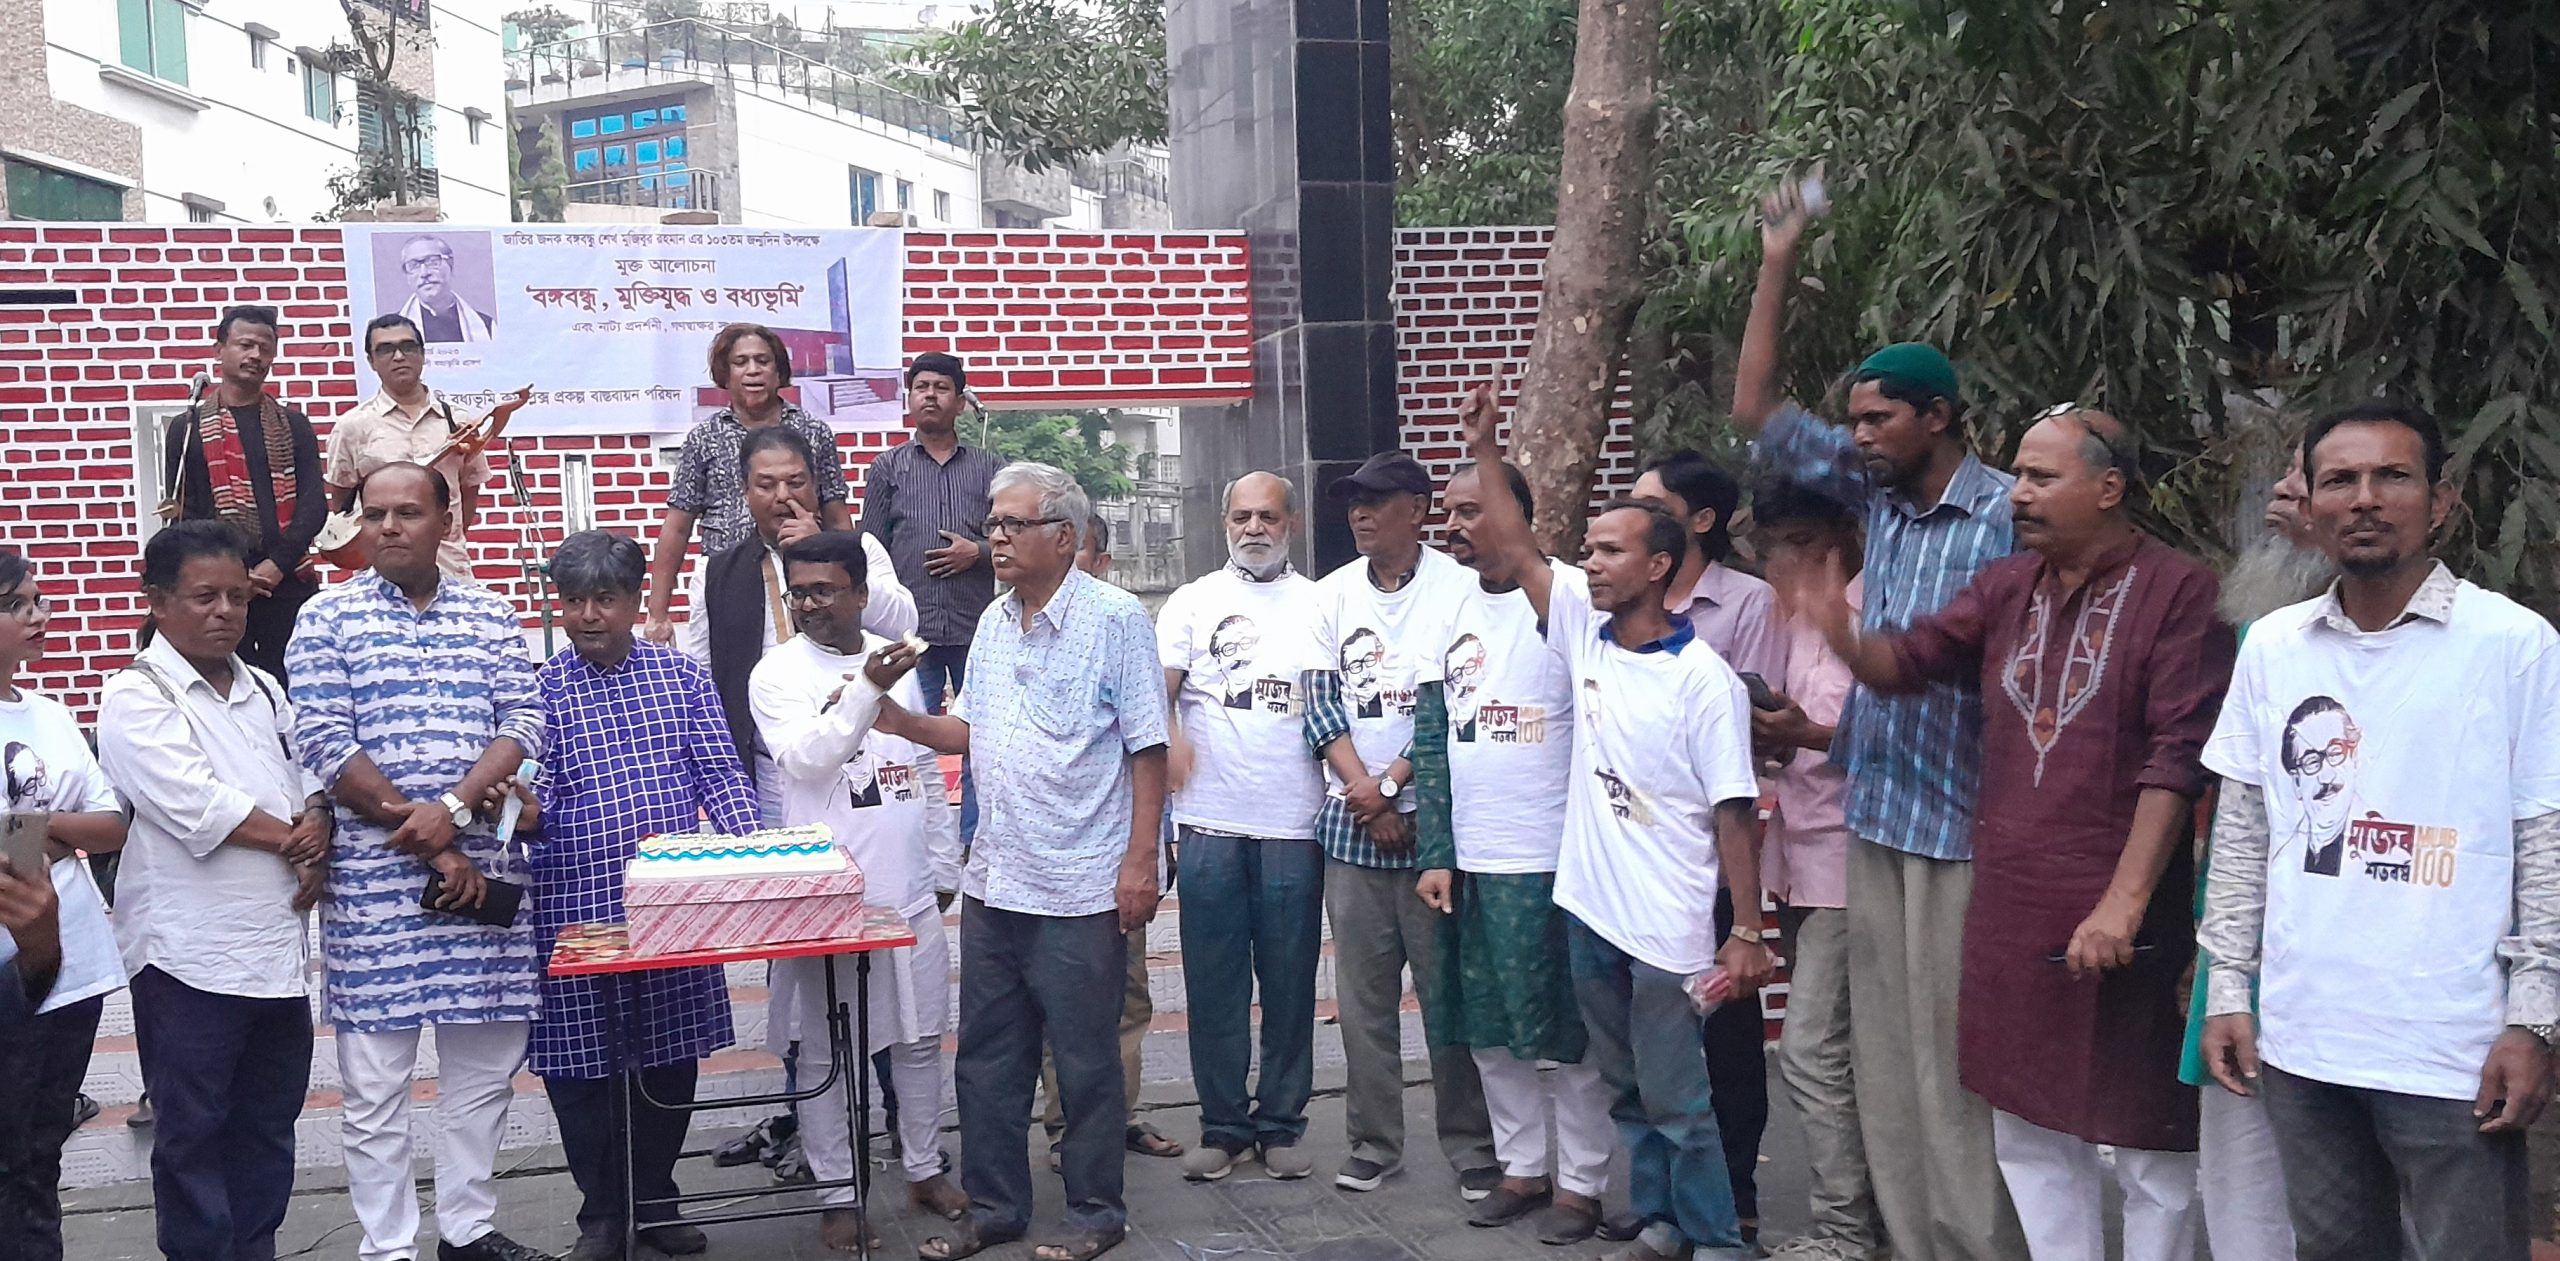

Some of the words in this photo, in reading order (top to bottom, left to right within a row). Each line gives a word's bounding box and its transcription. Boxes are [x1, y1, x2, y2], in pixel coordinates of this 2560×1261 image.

[503, 231, 533, 245] জাতির
[537, 233, 562, 245] জনক
[566, 233, 595, 247] বঙ্গবন্ধু
[599, 232, 617, 245] শেখ
[621, 230, 652, 247] মুজিবুর
[656, 233, 685, 245] রহমান
[688, 233, 703, 245] এর
[707, 233, 743, 246] ১০৩তম
[615, 259, 643, 276] মুক্ত
[648, 259, 716, 273] আলোচনা
[614, 281, 693, 311] মুক্তিযুদ্ধ
[700, 286, 718, 304] ও
[450, 388, 496, 409] বধ্যভূমি
[554, 390, 585, 404] প্রকল্প
[645, 384, 682, 401] পরিষদ
[2348, 810, 2416, 861] মুজিব
[2411, 848, 2455, 888] 100
